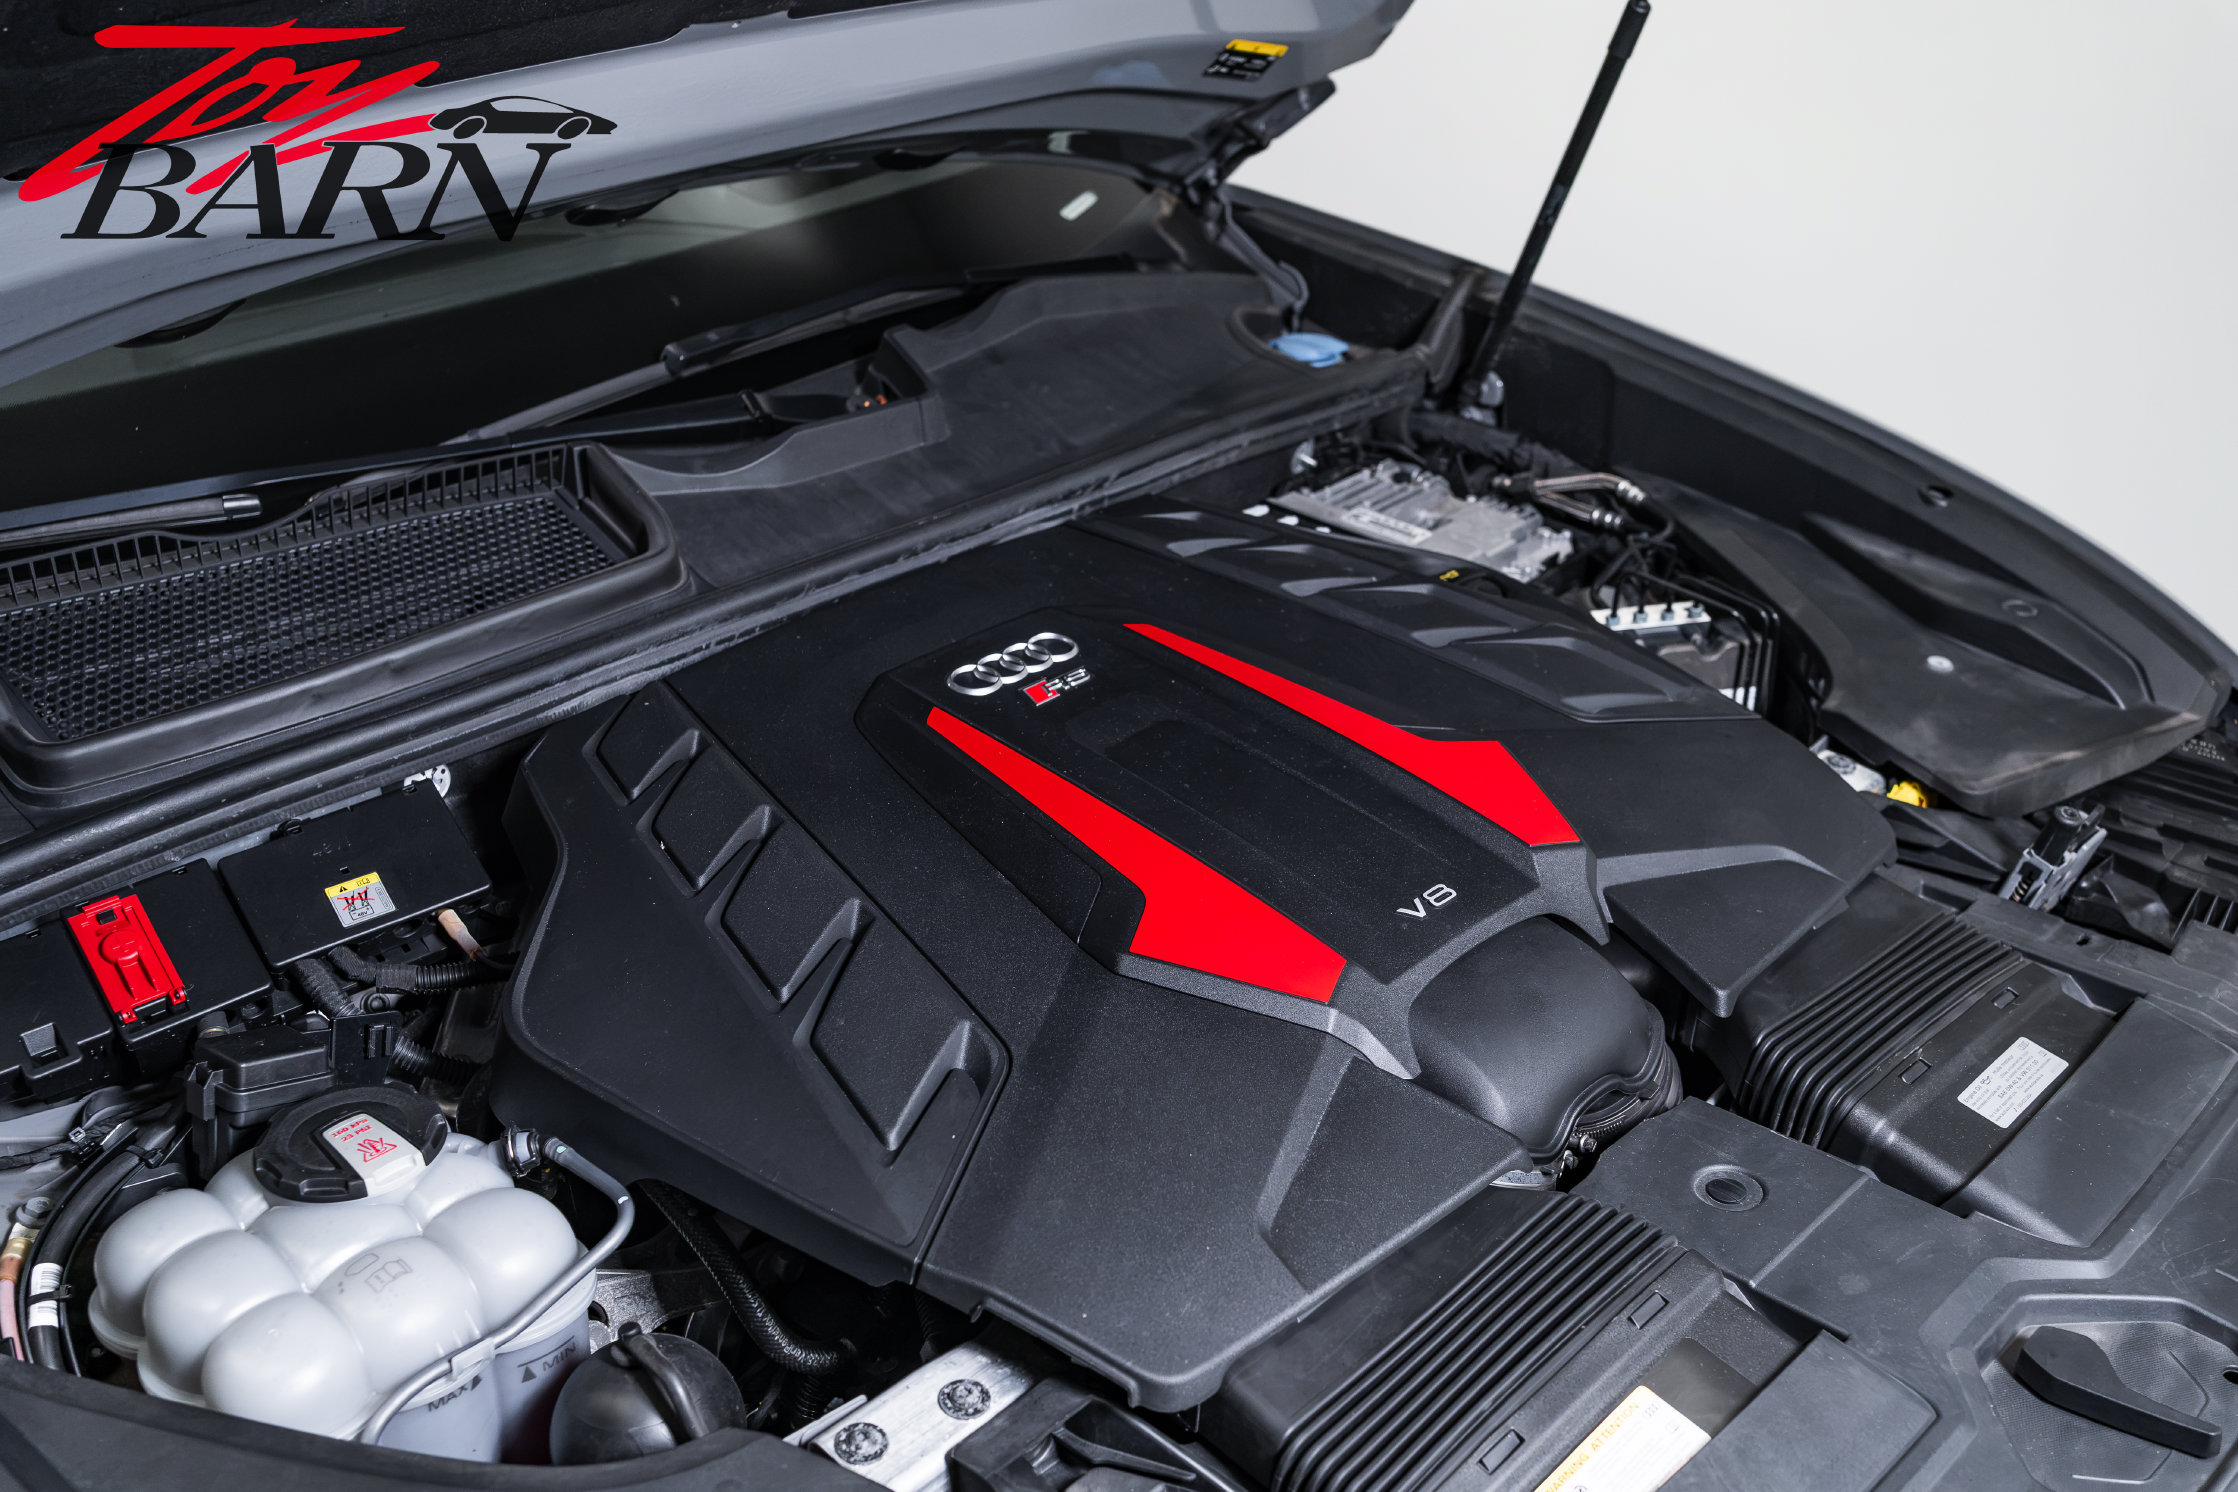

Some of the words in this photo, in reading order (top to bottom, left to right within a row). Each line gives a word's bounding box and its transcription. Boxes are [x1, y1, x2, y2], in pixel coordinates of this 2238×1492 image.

[1395, 883, 1457, 918] V8
[543, 1342, 576, 1372] MIN
[427, 1385, 468, 1412] MAX
[1590, 1401, 1640, 1451] ATTENTION
